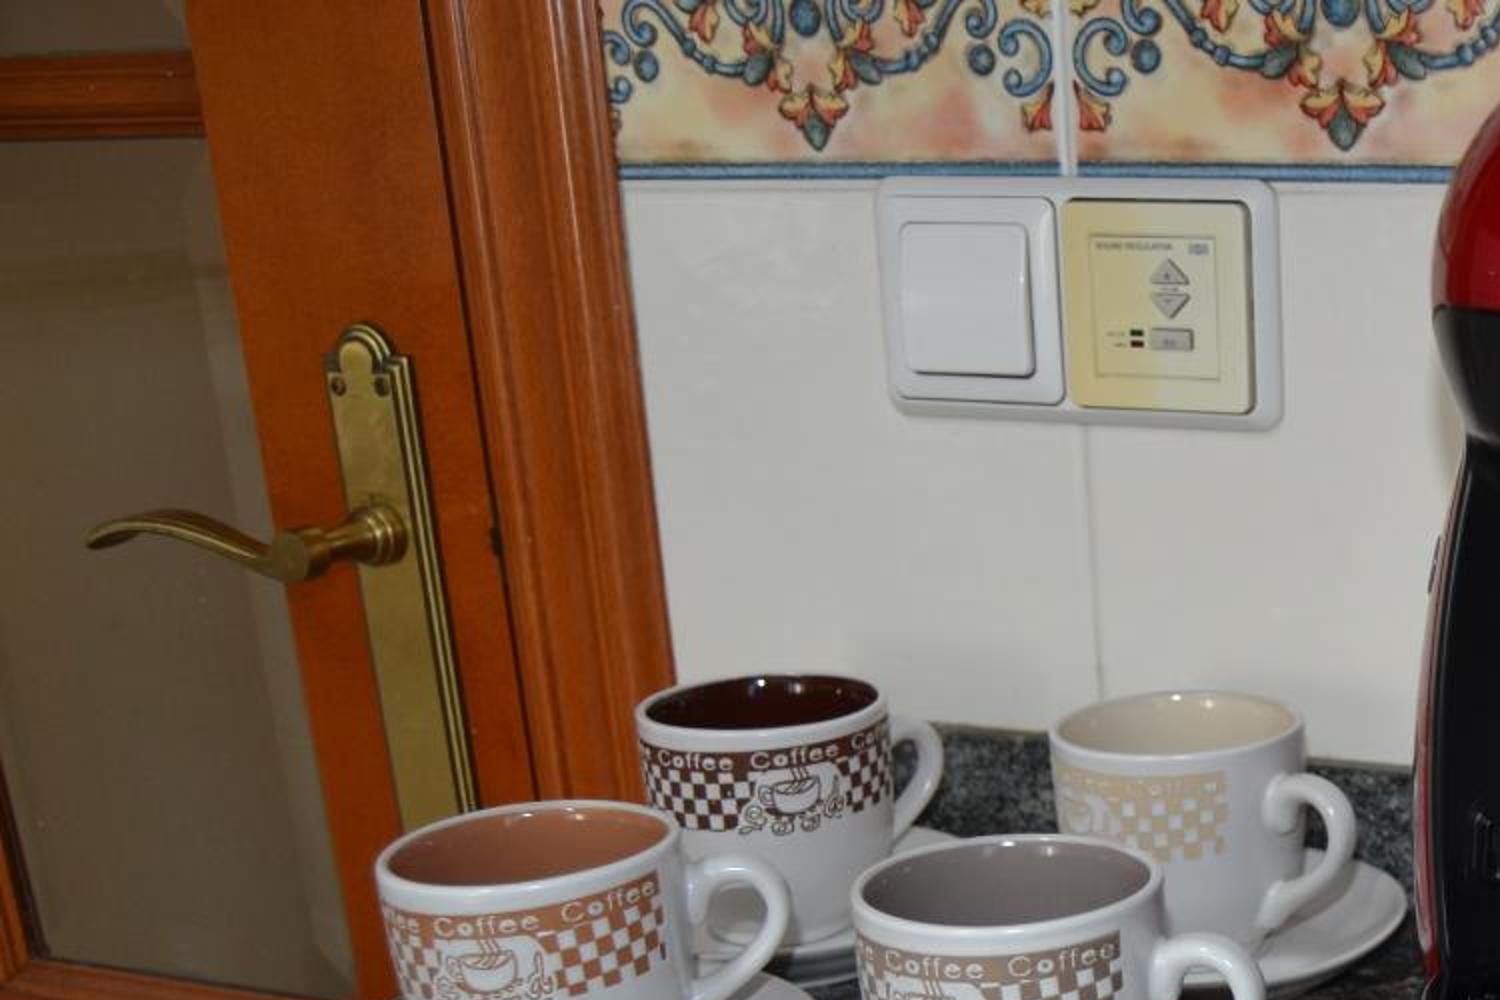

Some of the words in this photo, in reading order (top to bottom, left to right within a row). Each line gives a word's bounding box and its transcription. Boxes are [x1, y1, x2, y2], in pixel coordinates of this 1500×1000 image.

[657, 749, 734, 771] Coffee
[750, 743, 839, 770] Coffee
[433, 913, 540, 937] Coffee
[560, 880, 655, 922] Coffee
[885, 949, 985, 979] Coffee
[1007, 941, 1105, 976] Coffee
